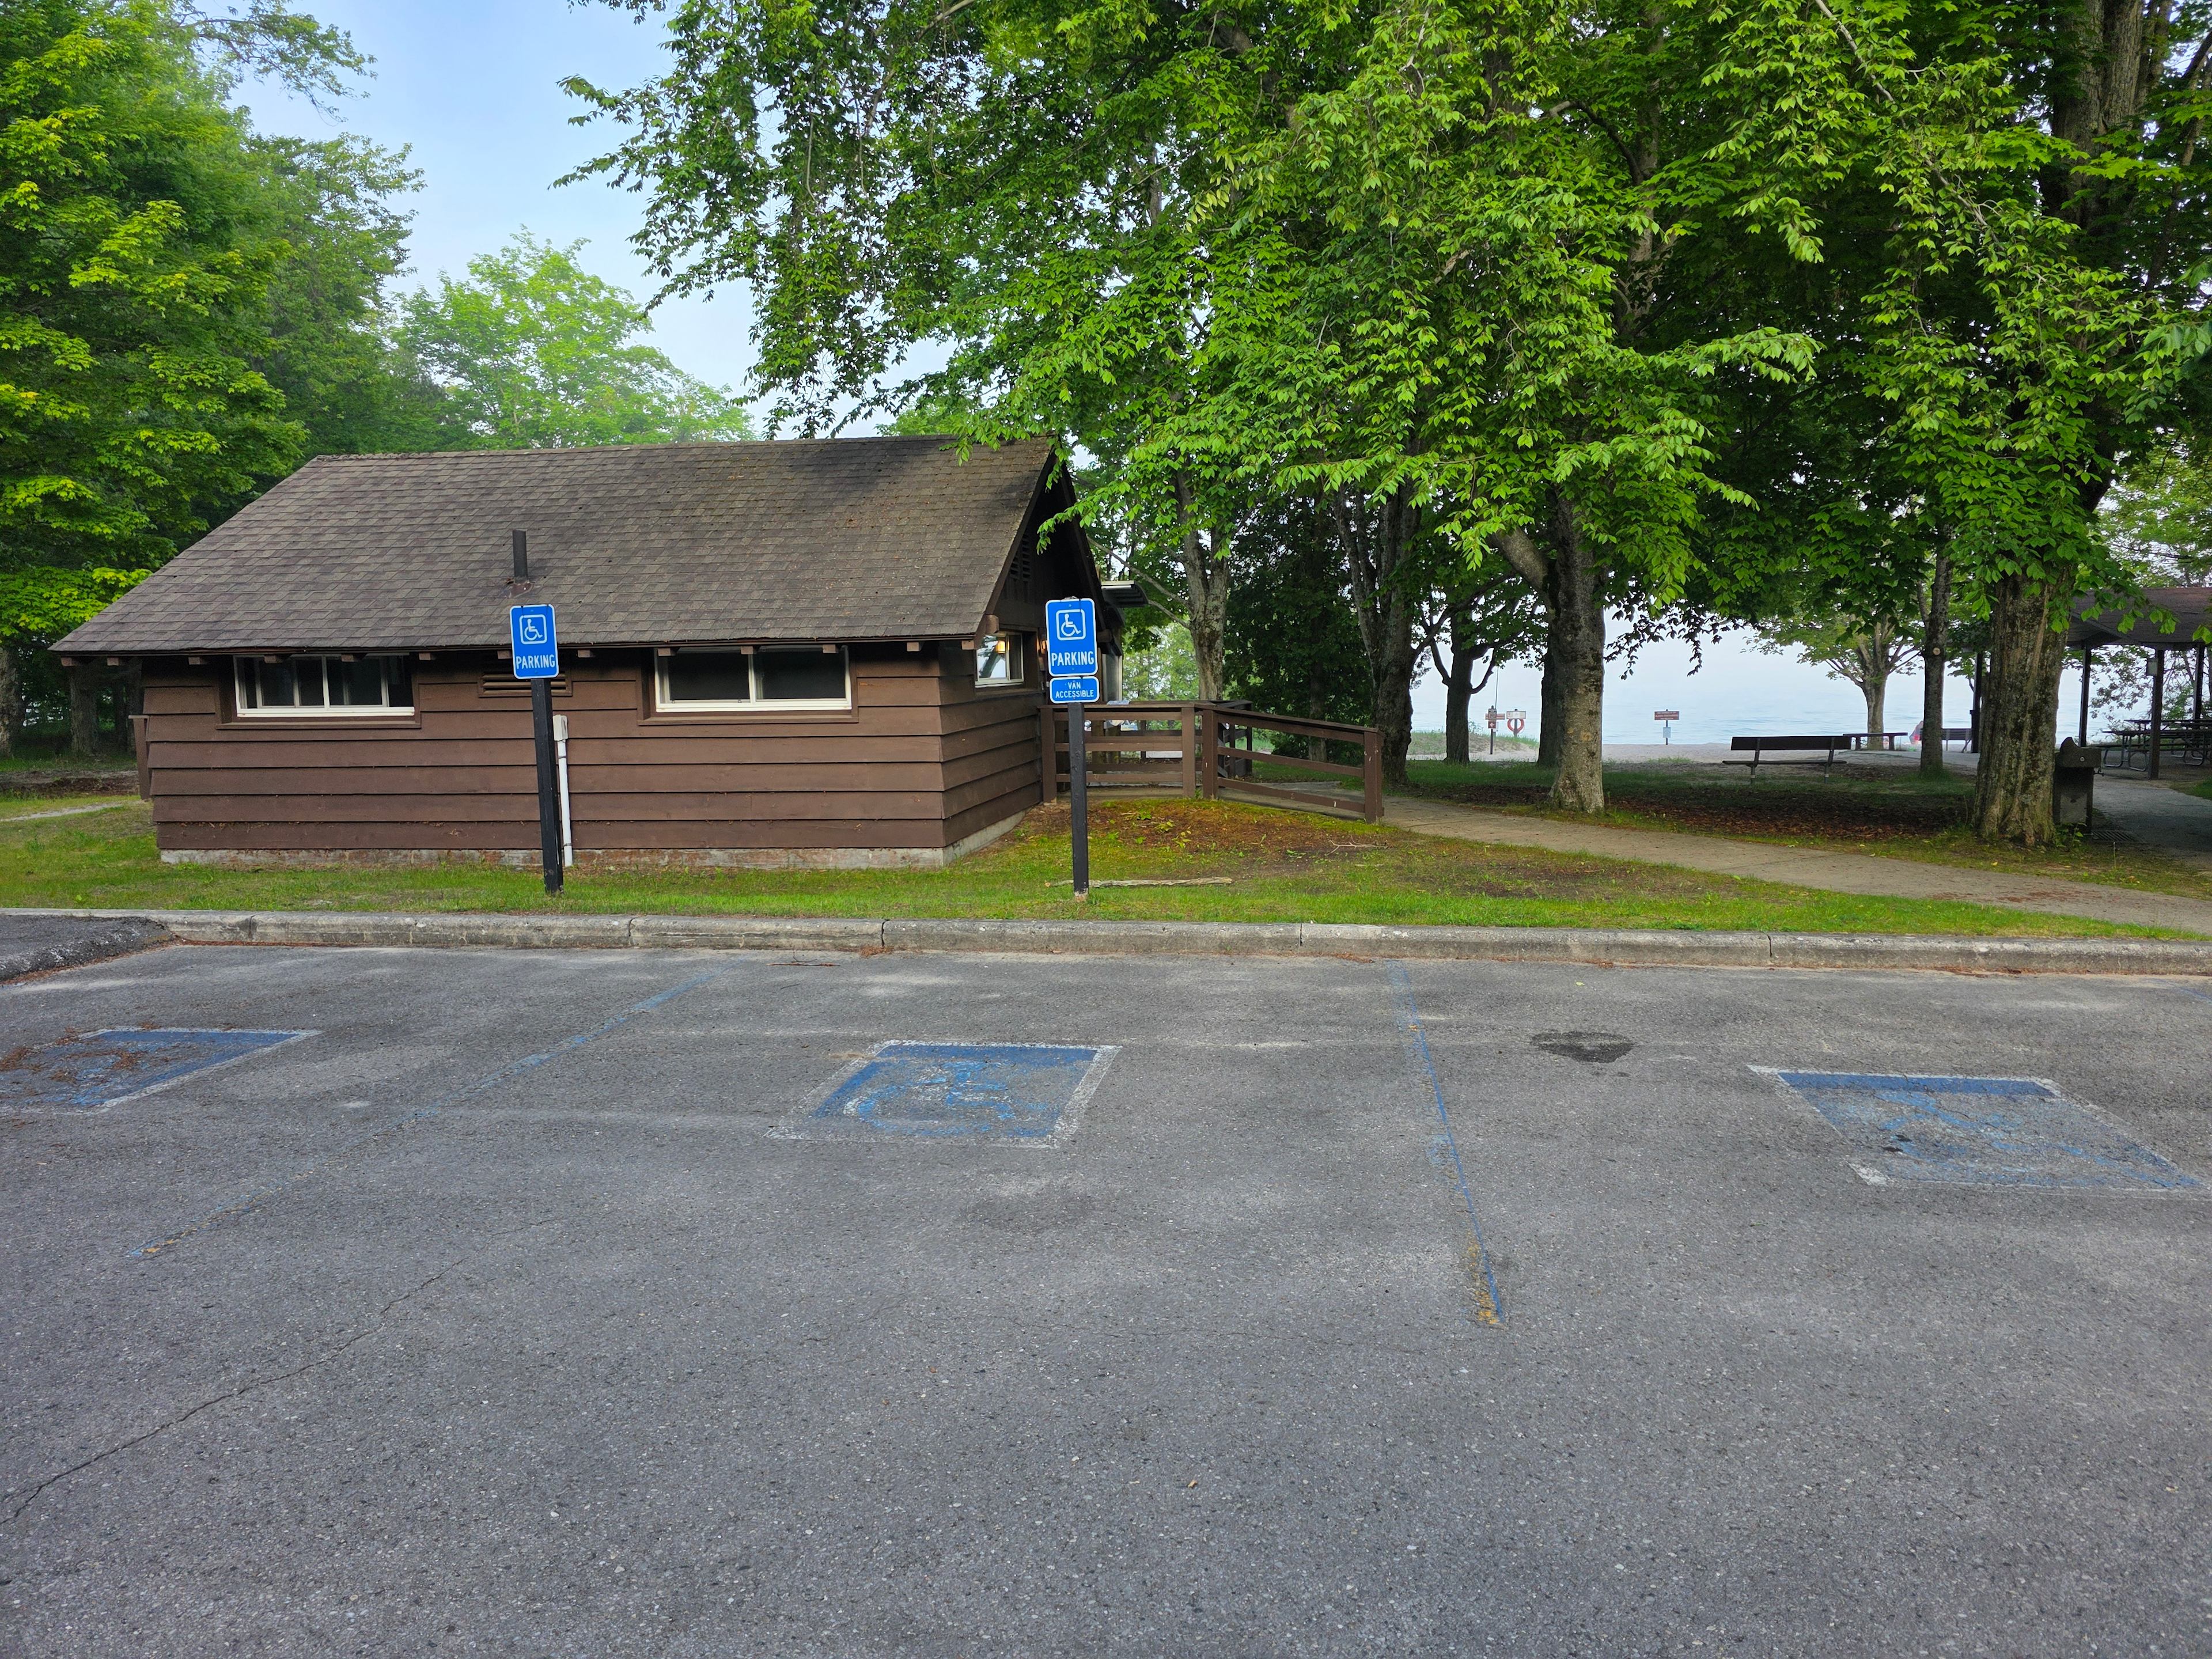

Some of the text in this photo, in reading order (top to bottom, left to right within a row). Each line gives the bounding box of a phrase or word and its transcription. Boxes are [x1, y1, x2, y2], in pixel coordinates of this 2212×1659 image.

[516, 654, 555, 669] PARKING
[1051, 651, 1094, 666] PARKING
[1055, 690, 1094, 698] ACCESSIBLE
